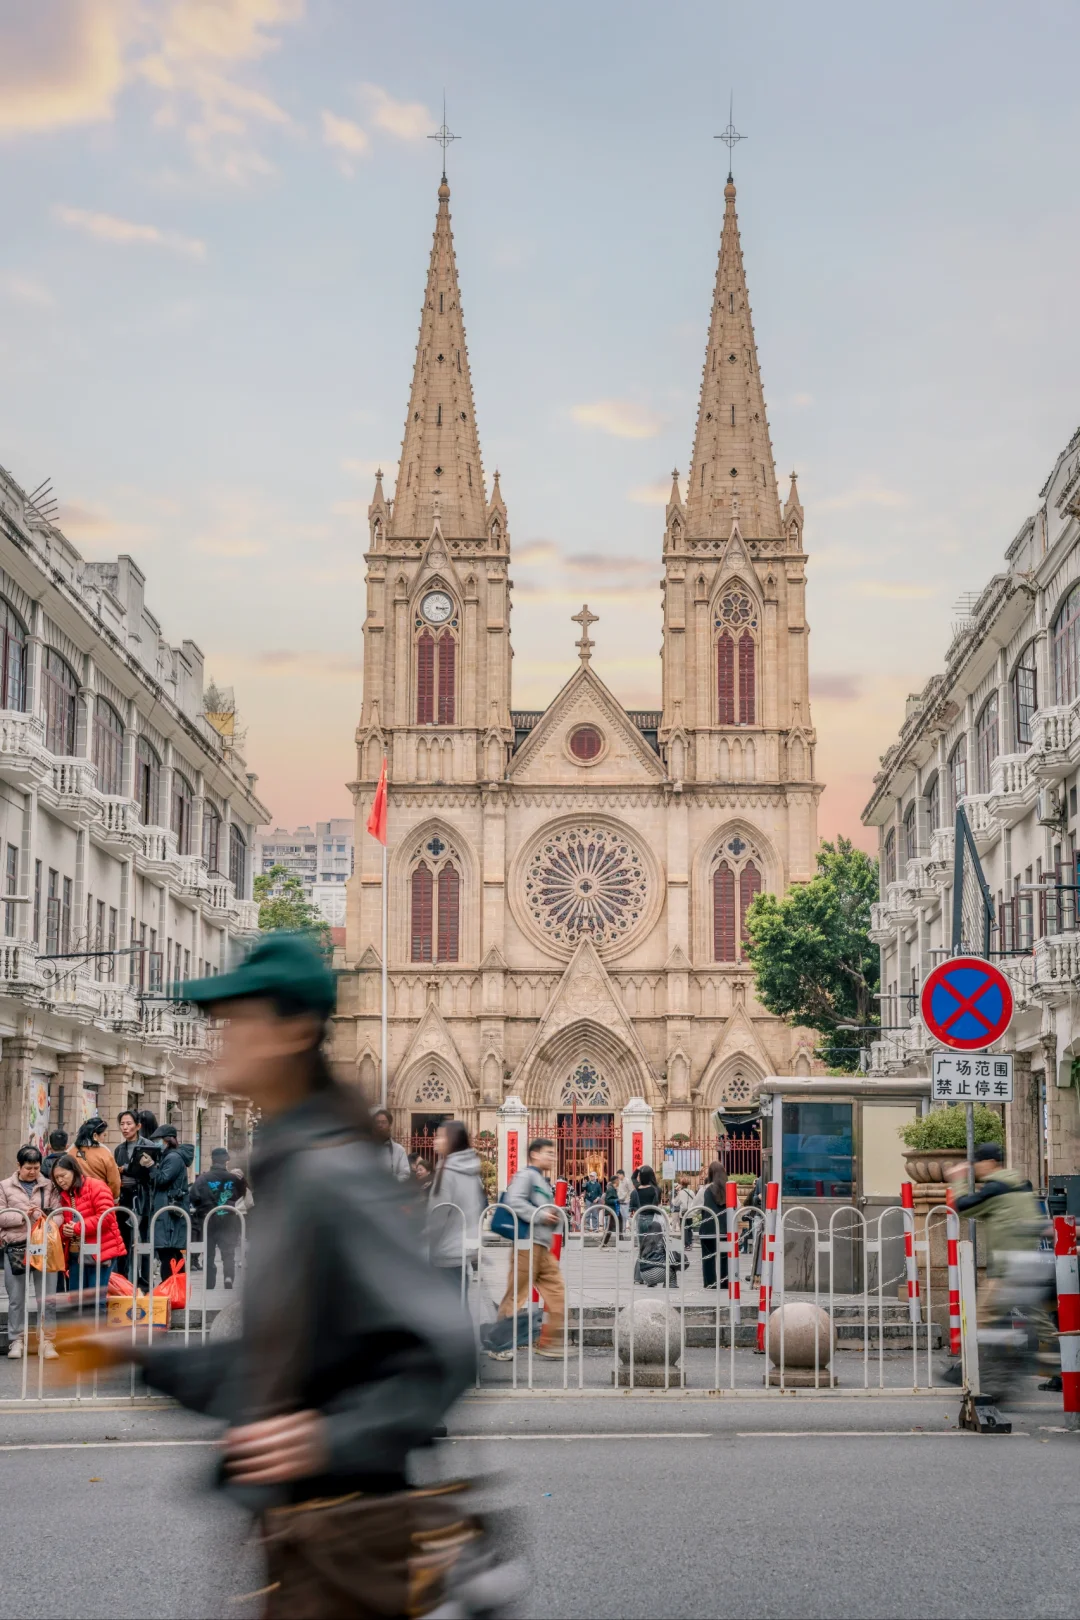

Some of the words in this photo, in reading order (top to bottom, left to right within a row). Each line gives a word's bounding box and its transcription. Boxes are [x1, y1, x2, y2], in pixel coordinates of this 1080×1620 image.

[936, 1059, 1008, 1077] 广场范围
[936, 1079, 1009, 1097] 禁止停车
